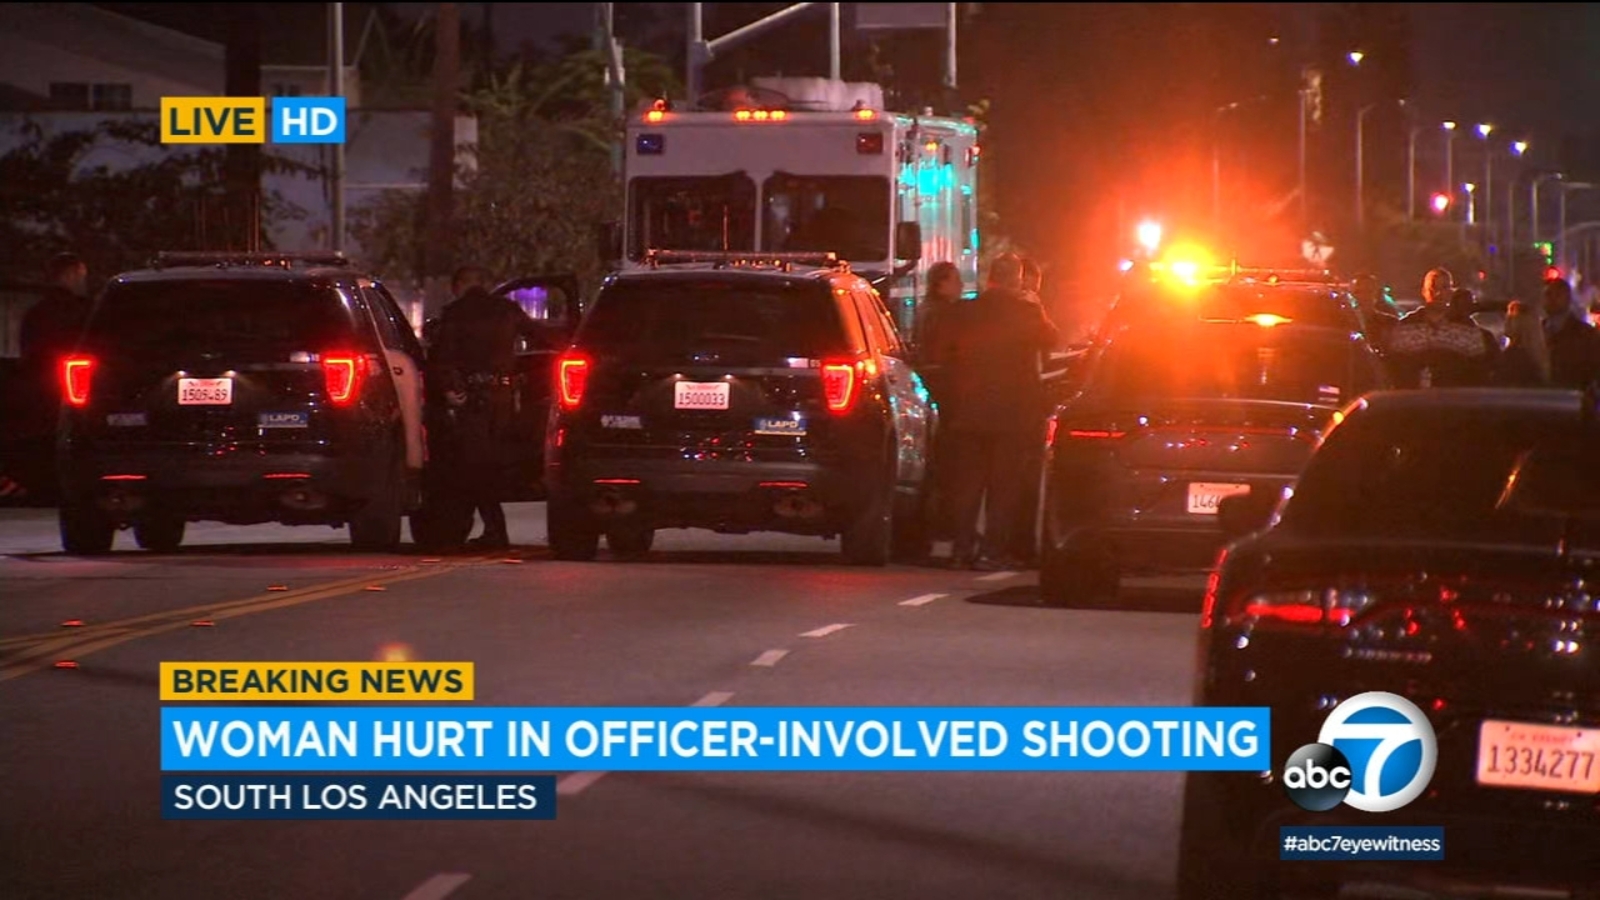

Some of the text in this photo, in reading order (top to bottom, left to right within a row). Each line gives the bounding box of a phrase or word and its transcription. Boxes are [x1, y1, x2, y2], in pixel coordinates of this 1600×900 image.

[268, 413, 299, 422] LAPD
[767, 419, 798, 429] LAPD
[1487, 746, 1595, 781] 1334277
